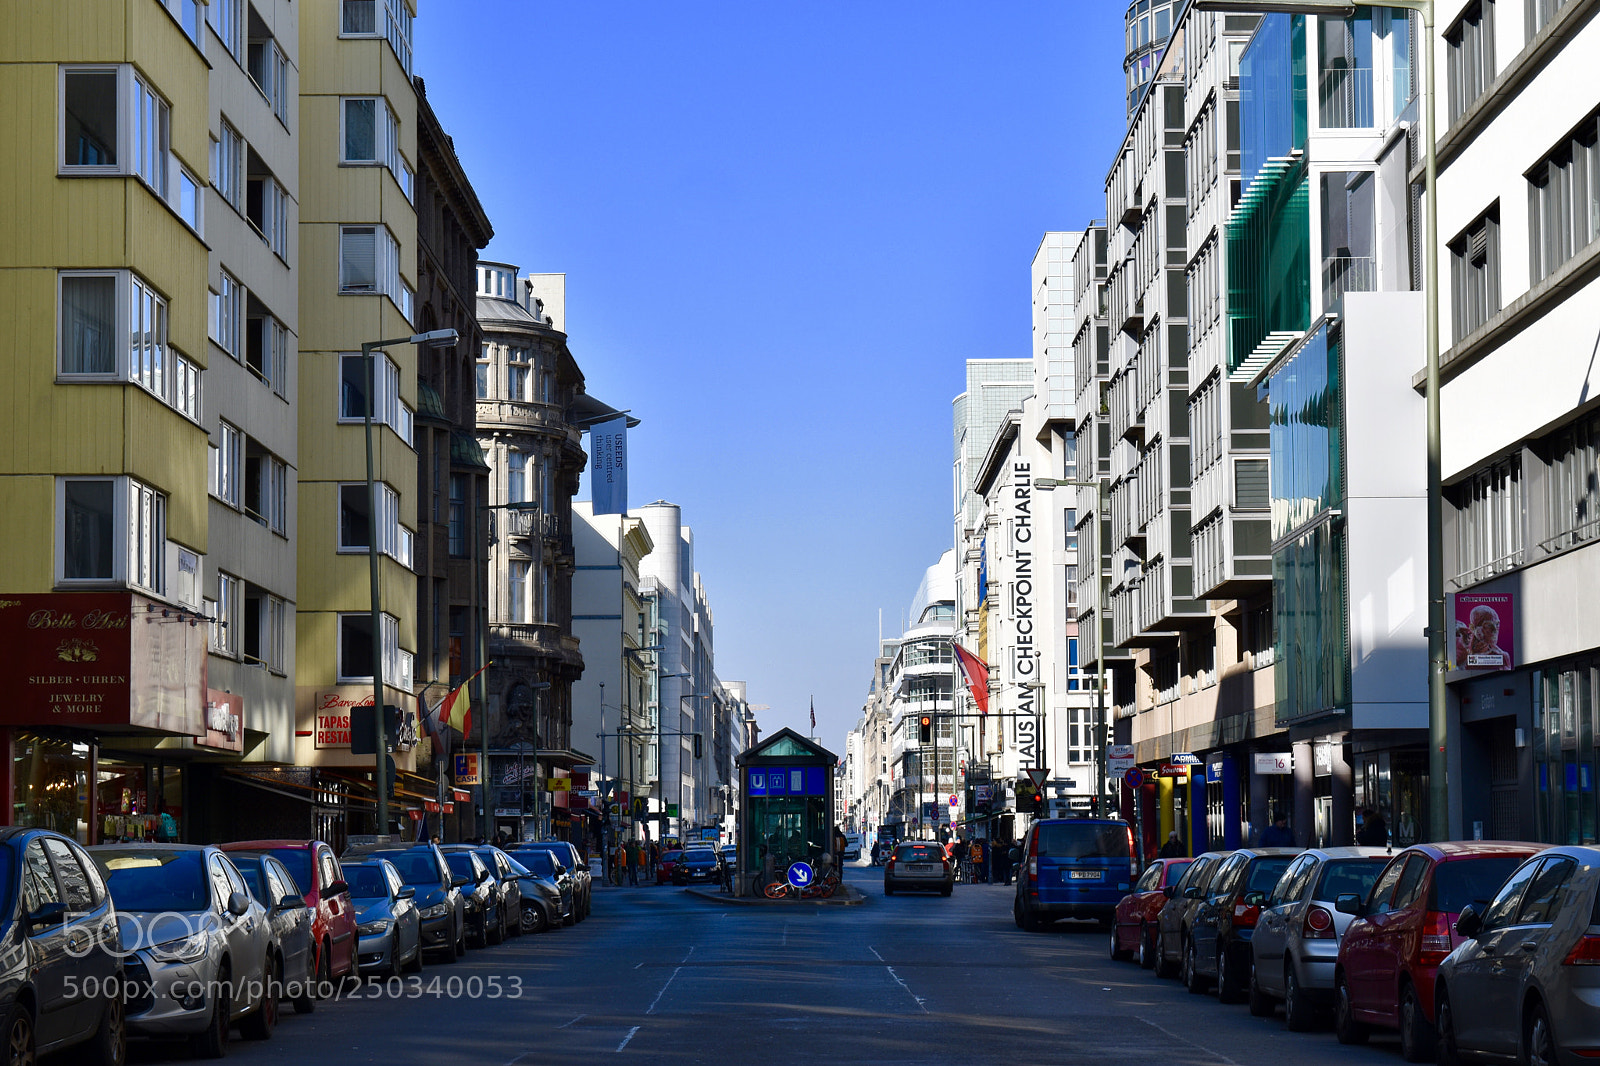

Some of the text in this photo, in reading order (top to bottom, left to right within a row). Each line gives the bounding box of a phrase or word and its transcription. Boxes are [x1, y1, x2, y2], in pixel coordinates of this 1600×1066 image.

[594, 434, 604, 470] thinking
[606, 453, 614, 484] centred
[27, 608, 129, 630] Belle Arti
[1014, 462, 1035, 773] HAUS AM CHECKPOINT CHARLIE
[28, 675, 126, 684] SILBER UHREN
[48, 693, 105, 703] JEWELRY
[52, 704, 102, 713] & MORE
[1274, 758, 1285, 769] 16
[455, 775, 478, 783] CASH
[752, 775, 763, 788] U
[1399, 821, 1414, 837] M
